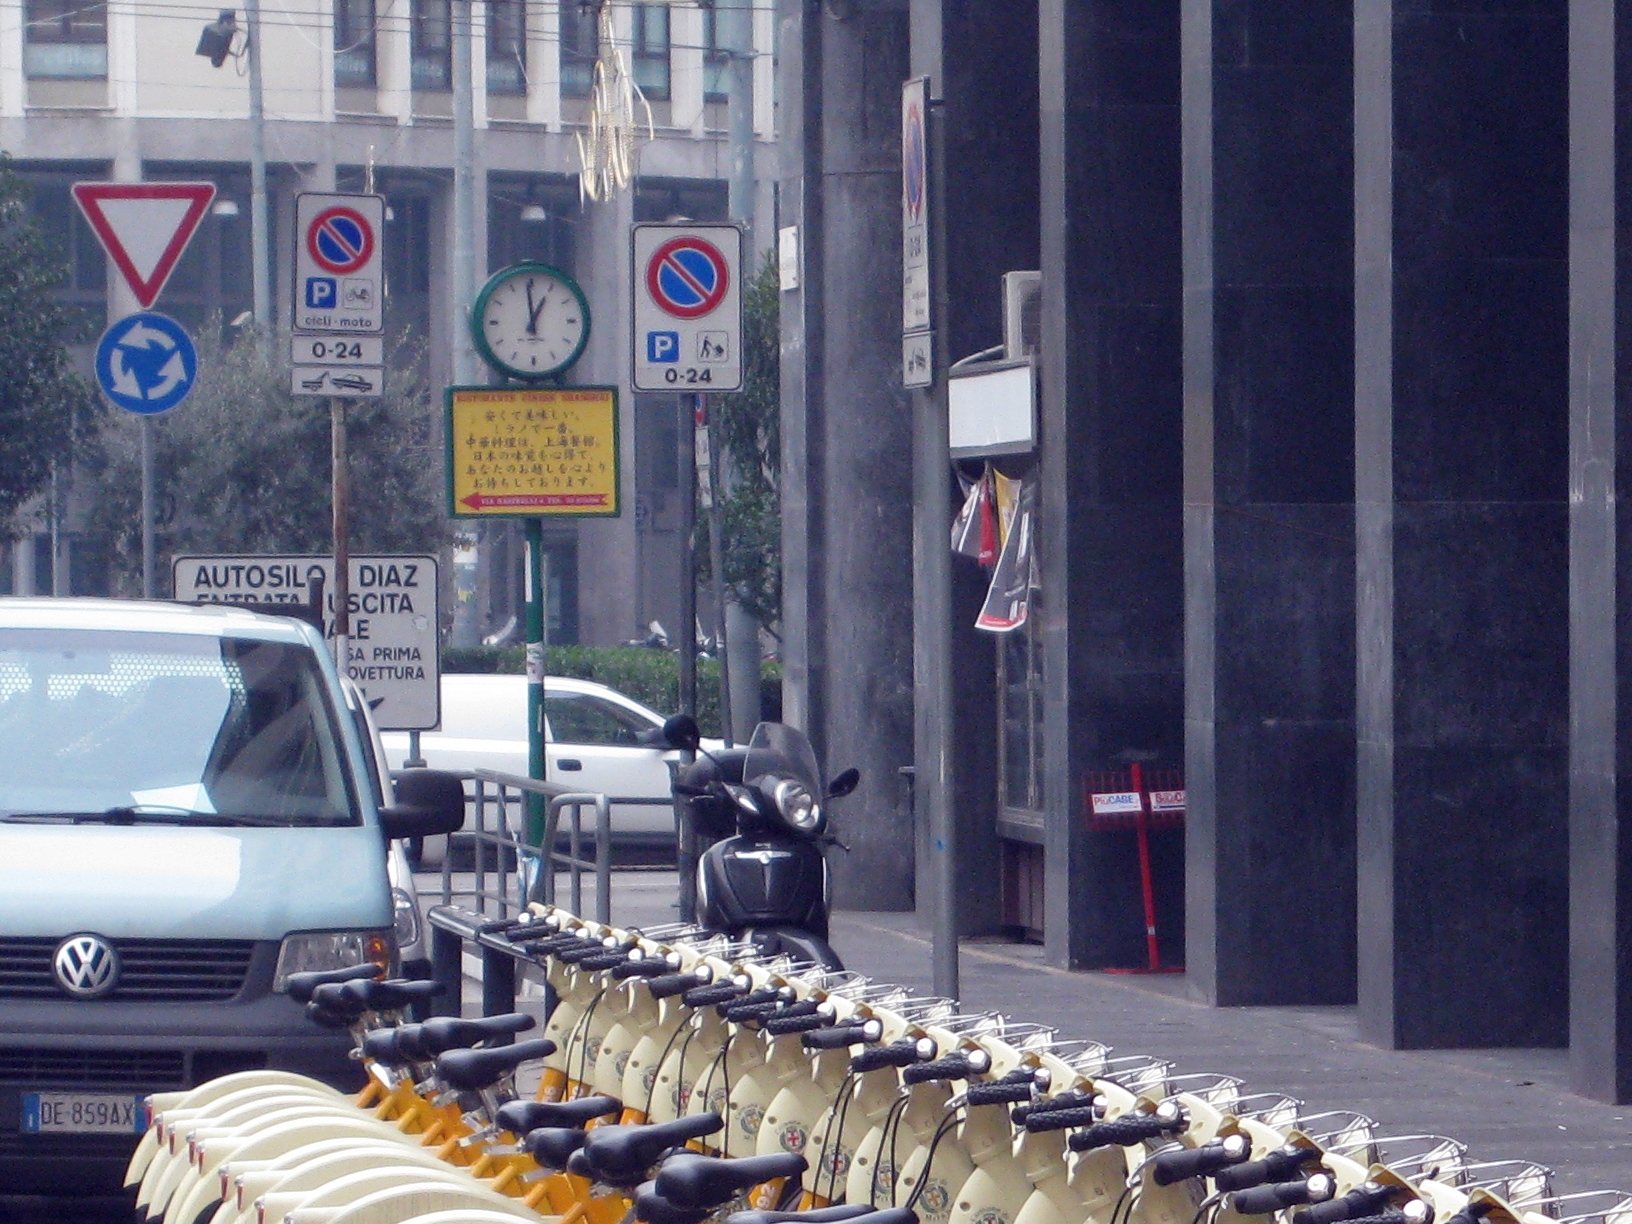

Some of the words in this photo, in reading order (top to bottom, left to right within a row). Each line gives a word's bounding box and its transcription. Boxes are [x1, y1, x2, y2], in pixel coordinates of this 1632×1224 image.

[312, 341, 362, 359] 0-24
[665, 368, 712, 384] 0-24
[360, 564, 418, 588] DIAZ
[373, 647, 421, 661] PRIMA
